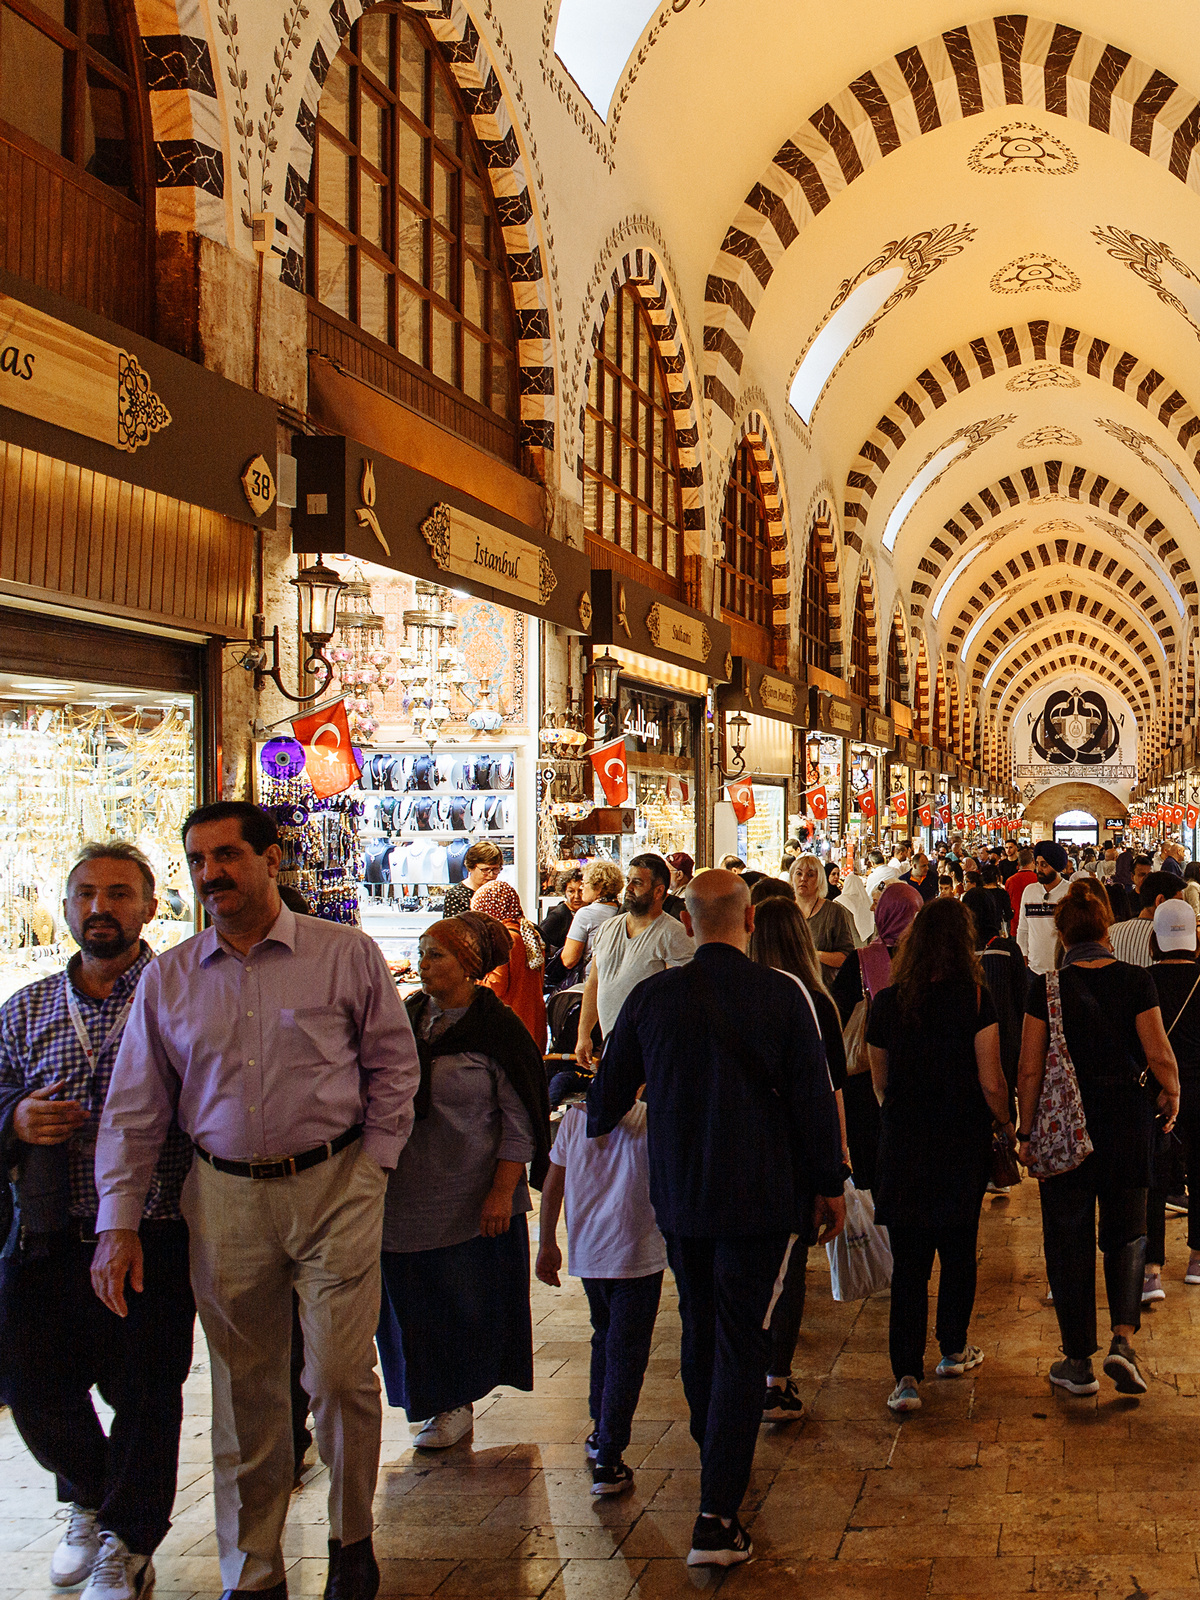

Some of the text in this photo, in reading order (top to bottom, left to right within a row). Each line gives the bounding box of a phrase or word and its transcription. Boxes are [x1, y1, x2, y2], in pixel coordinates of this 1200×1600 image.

[251, 469, 271, 501] 38
[472, 535, 521, 580] İstanbul
[671, 624, 692, 646] Sultani
